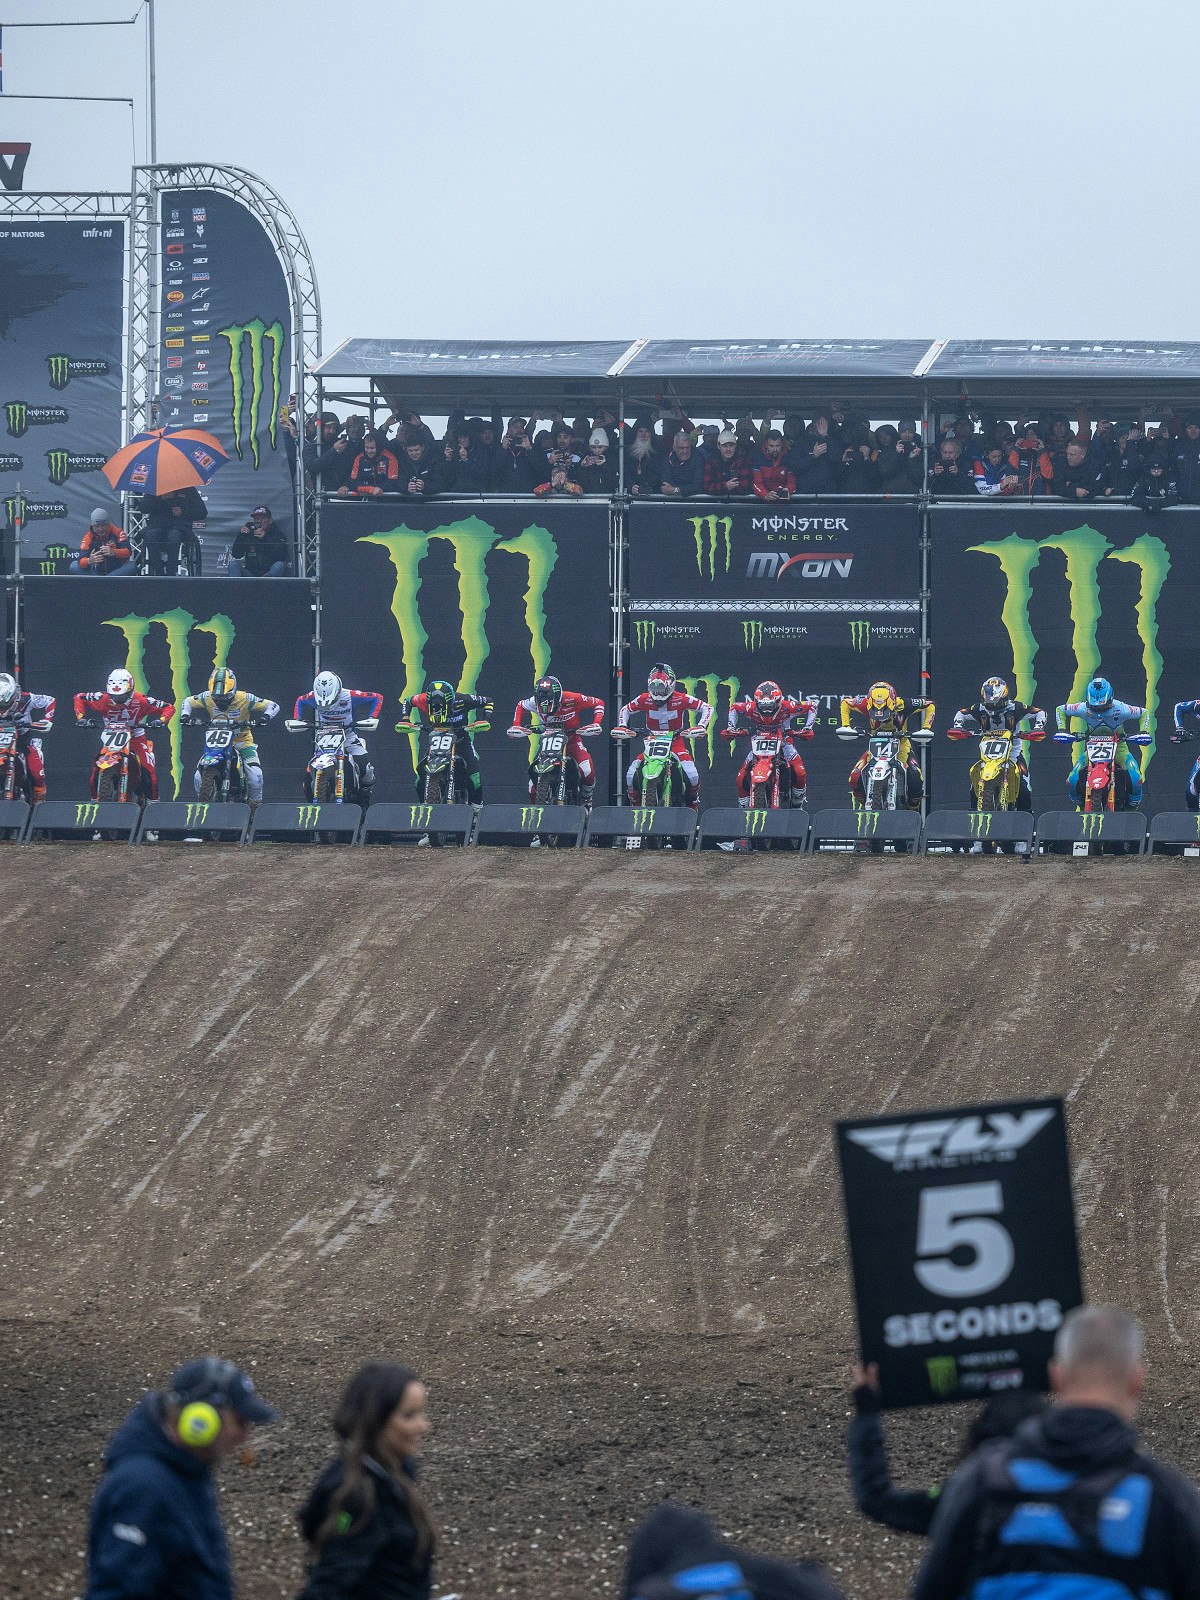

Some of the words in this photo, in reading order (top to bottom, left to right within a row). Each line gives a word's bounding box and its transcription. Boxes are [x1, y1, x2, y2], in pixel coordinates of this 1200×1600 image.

[751, 514, 850, 532] MONSTER
[656, 625, 701, 635] MONSTER
[763, 625, 808, 635] MONSTER
[871, 625, 915, 635] MONSTER
[104, 731, 129, 747] 70
[206, 731, 231, 745] 46
[318, 734, 343, 748] 44
[430, 736, 453, 750] 38
[541, 737, 564, 751] 116
[755, 740, 777, 751] 109
[874, 742, 893, 758] 14
[983, 740, 1007, 755] 10
[1091, 746, 1112, 759] 25
[846, 1106, 1057, 1163] FLY
[913, 1179, 1015, 1299] 5
[883, 1298, 1064, 1348] SECONDS
